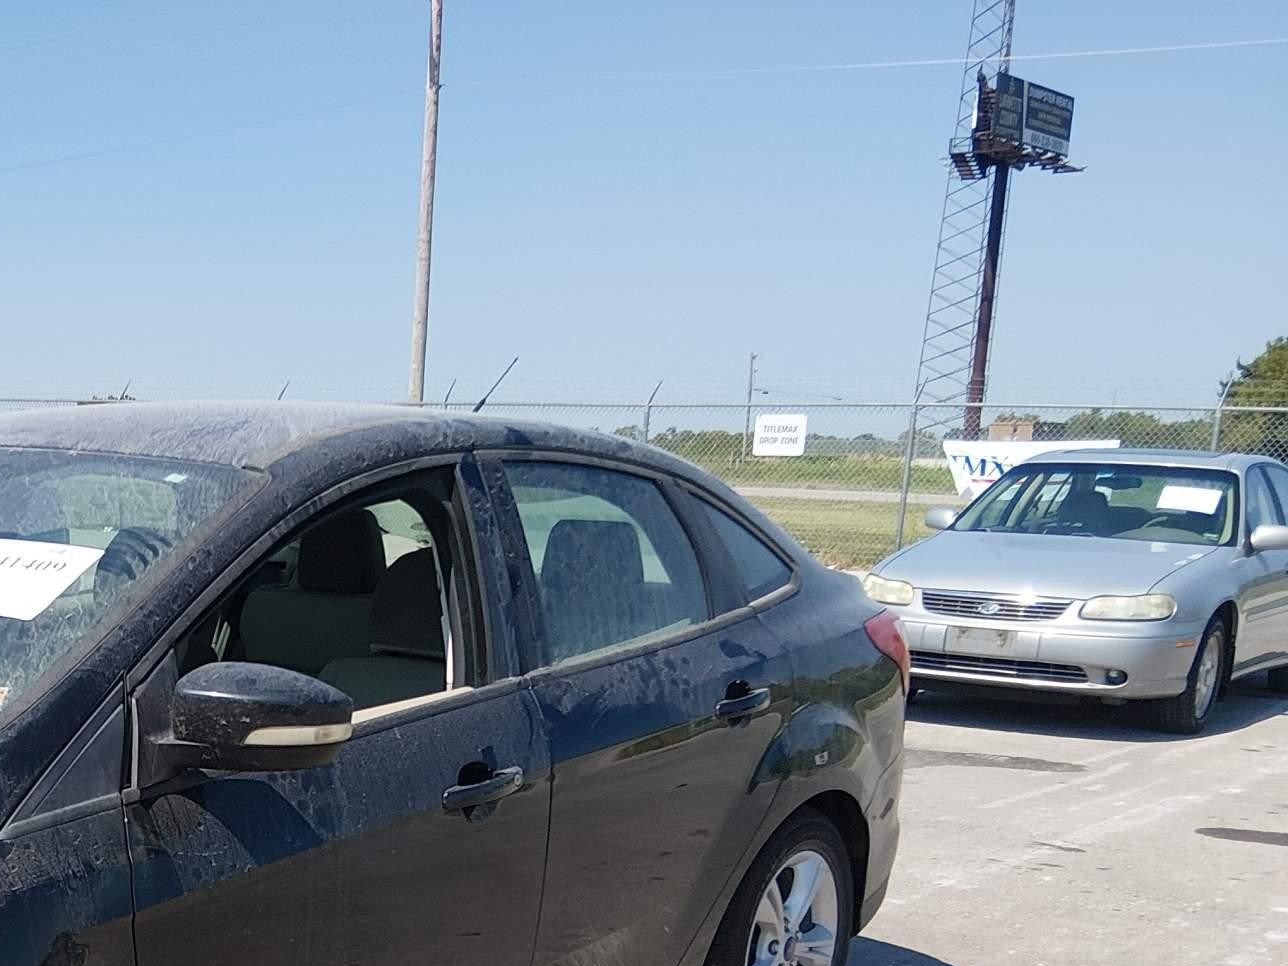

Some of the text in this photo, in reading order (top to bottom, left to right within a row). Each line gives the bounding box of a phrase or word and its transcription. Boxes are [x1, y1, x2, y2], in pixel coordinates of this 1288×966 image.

[763, 425, 798, 433] TITLEMAX
[759, 436, 799, 444] DROP ZONE
